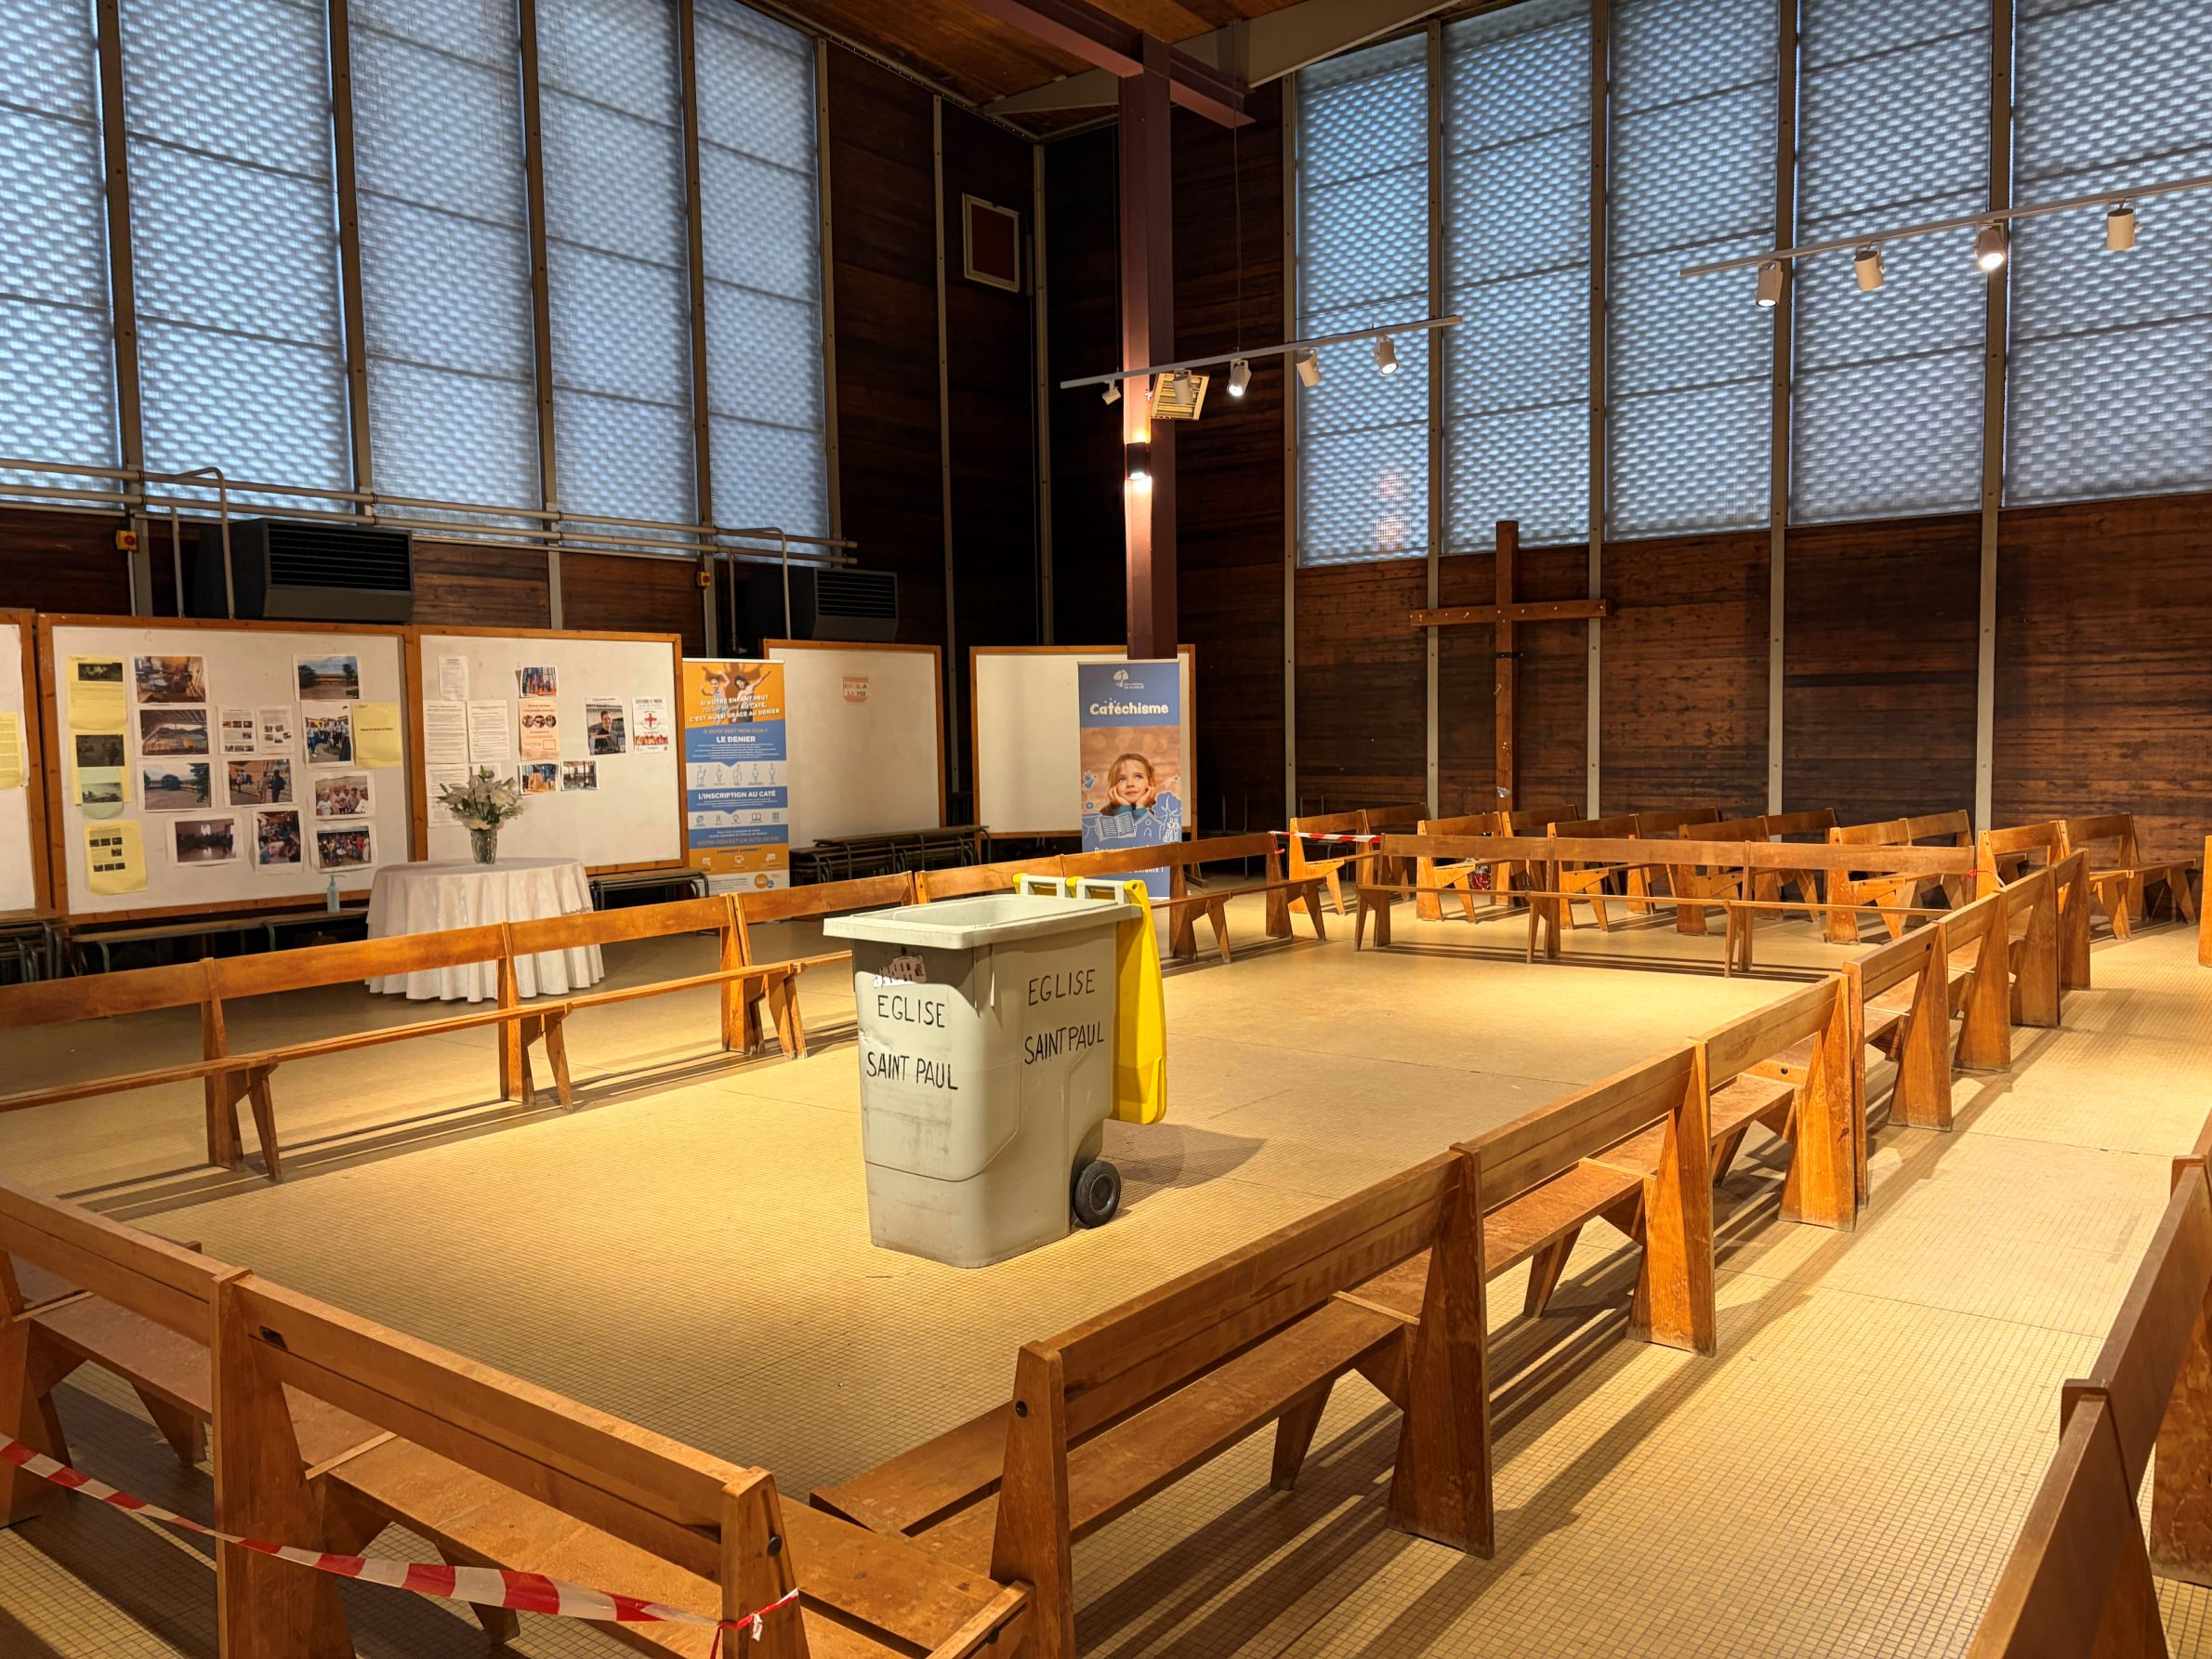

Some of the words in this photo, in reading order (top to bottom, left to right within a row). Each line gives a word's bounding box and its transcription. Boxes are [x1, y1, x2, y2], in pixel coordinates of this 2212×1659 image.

[706, 697, 727, 705] VOTRE
[729, 695, 753, 704] ENFANT
[1089, 700, 1169, 716] Catéchisme
[728, 709, 747, 718] GRÂCE
[758, 707, 780, 716] DENIER
[698, 791, 746, 800] L'INSCRIPTION
[758, 789, 776, 797] CATÉ
[1028, 968, 1097, 1007] EGLISE
[877, 994, 946, 1029] EGLISE
[865, 1051, 910, 1082] SAINT
[915, 1060, 959, 1091] PAUL
